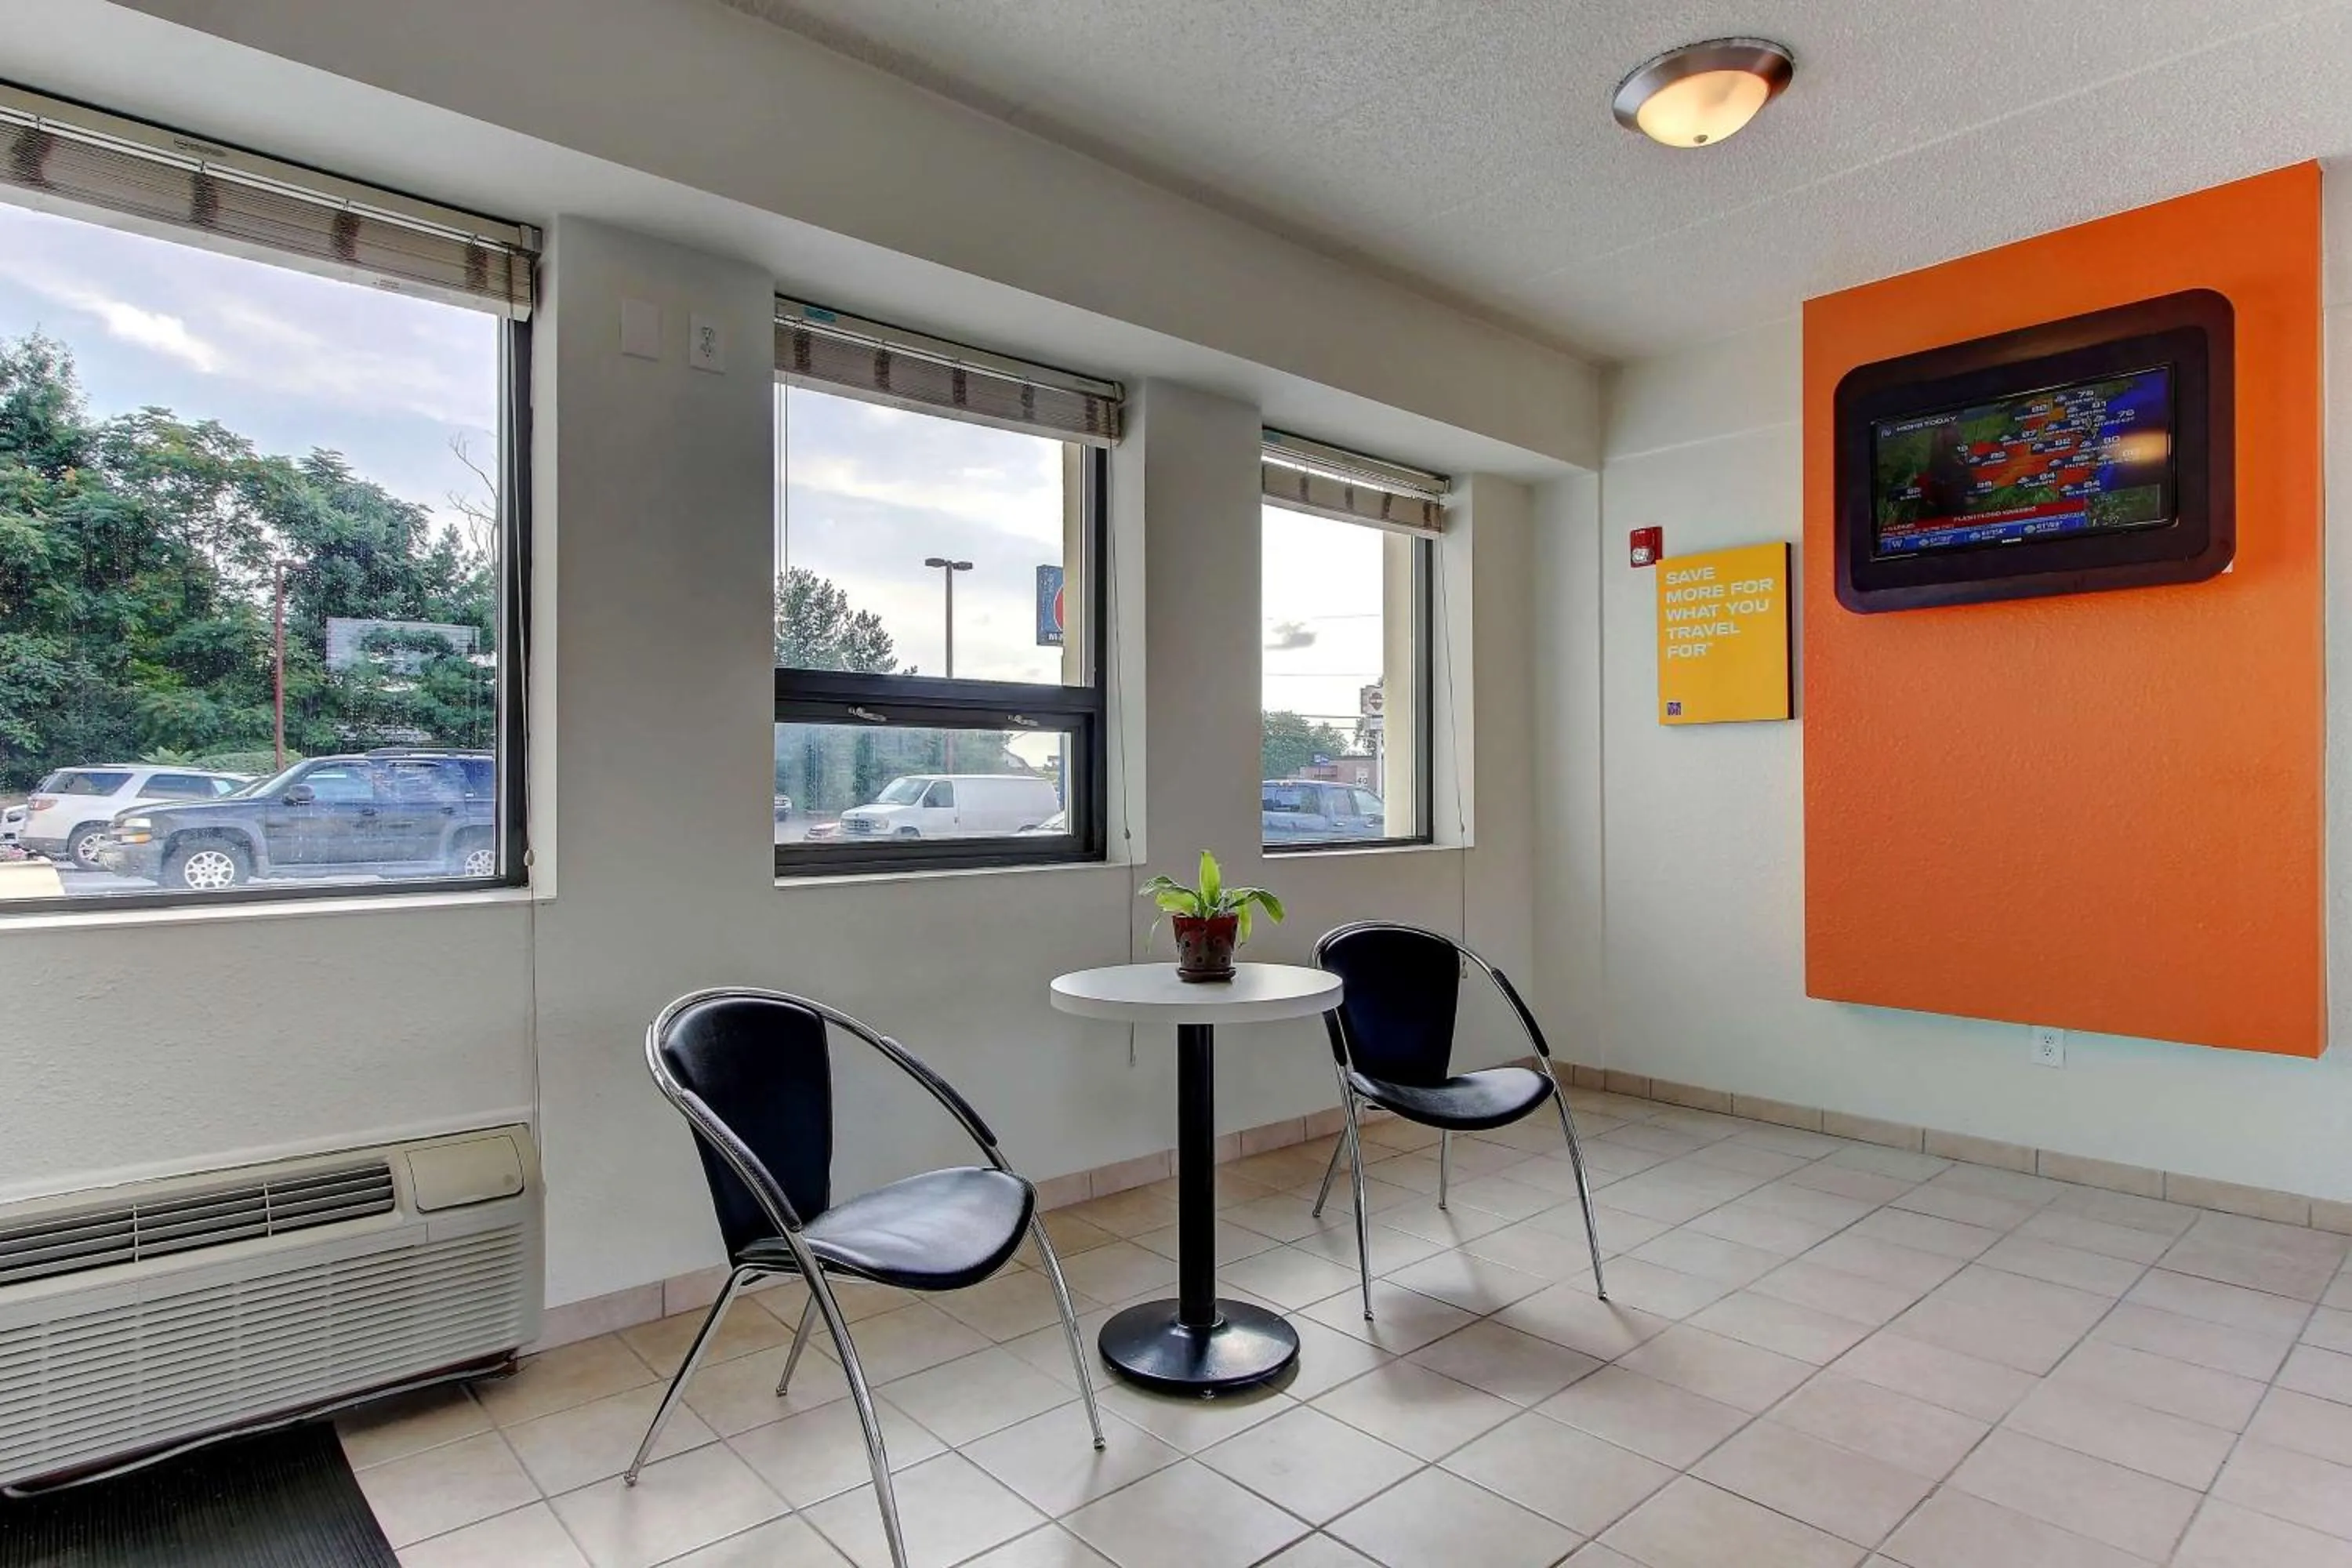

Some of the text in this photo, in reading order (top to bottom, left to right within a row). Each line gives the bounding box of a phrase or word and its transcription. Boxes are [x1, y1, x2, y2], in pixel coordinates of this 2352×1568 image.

[1666, 567, 1715, 585] SAVE
[1666, 578, 1774, 603] MORE FOR
[1666, 599, 1769, 622] WHAT YOU
[1667, 622, 1740, 640] TRAVEL
